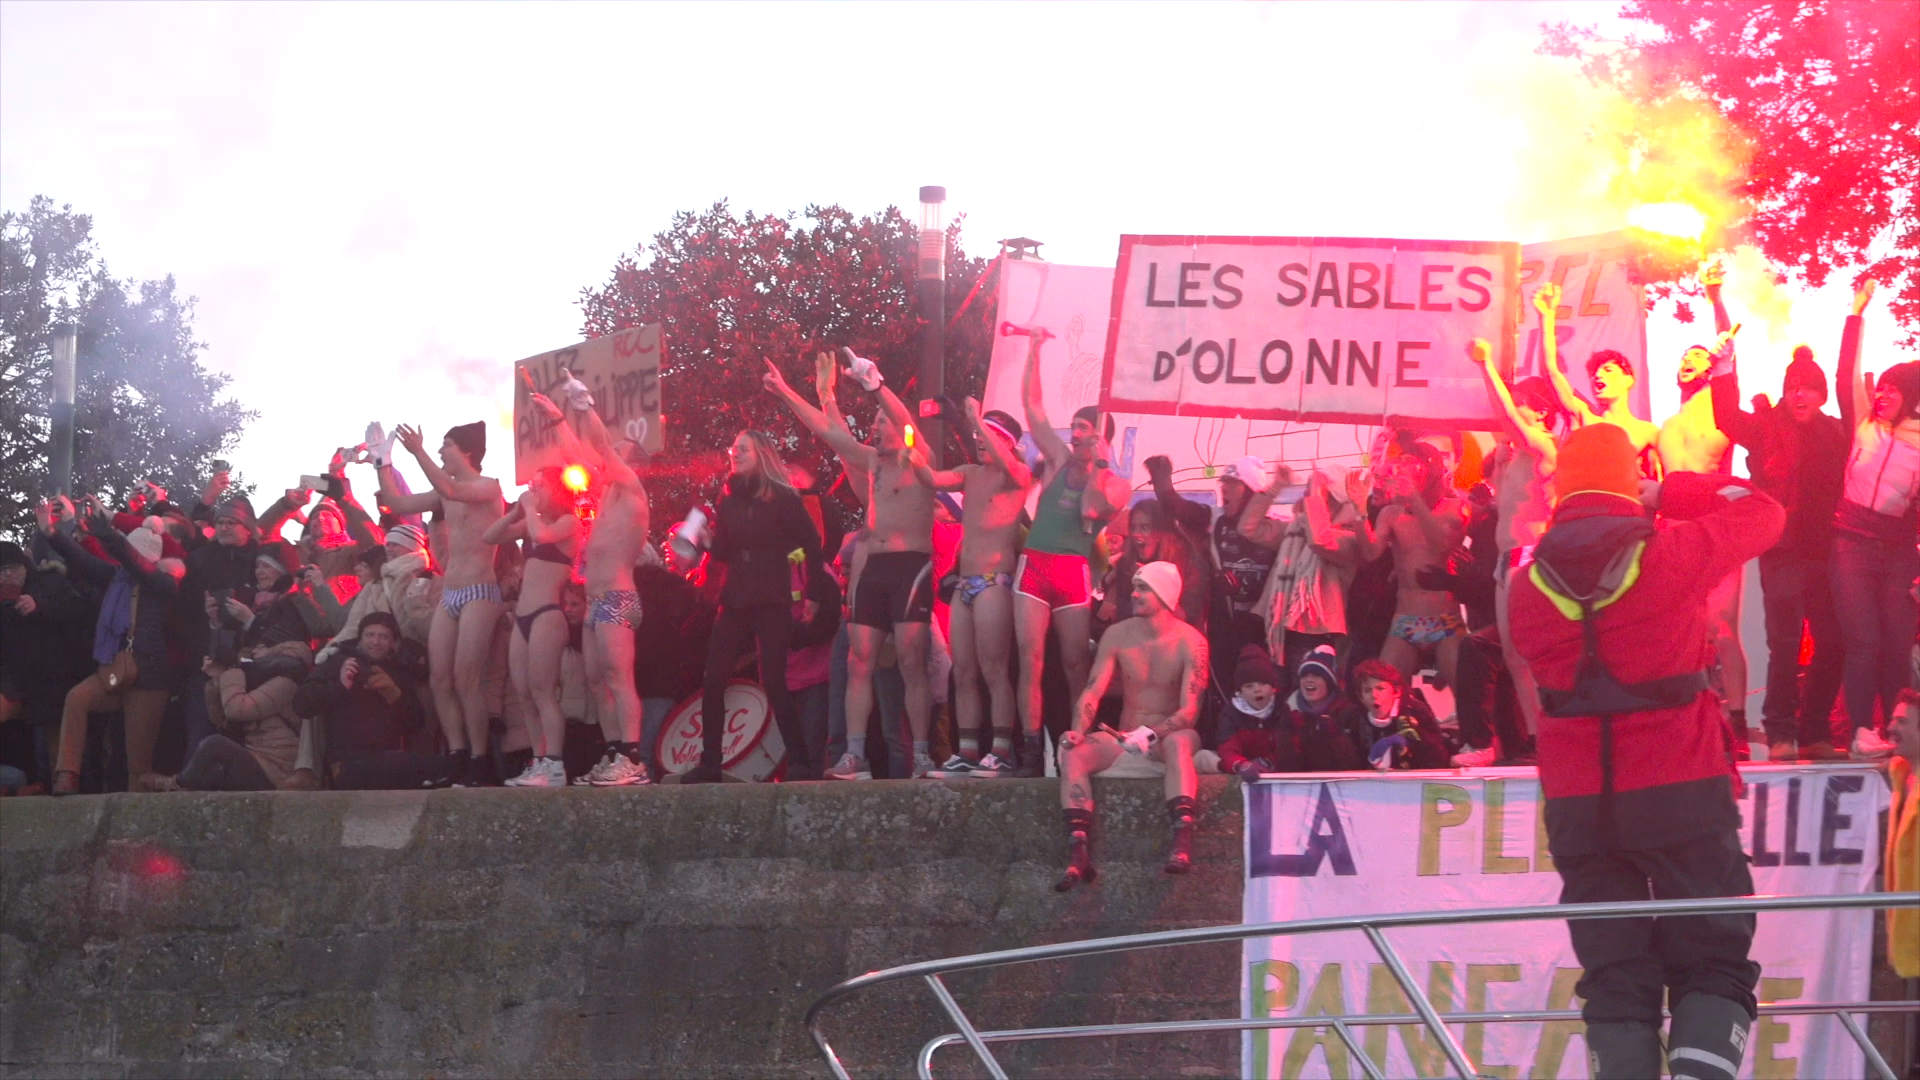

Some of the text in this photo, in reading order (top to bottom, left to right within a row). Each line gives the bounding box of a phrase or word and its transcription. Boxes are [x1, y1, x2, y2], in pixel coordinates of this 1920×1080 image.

[1146, 262, 1492, 312] LES SABLES
[1249, 782, 1357, 878] LA
